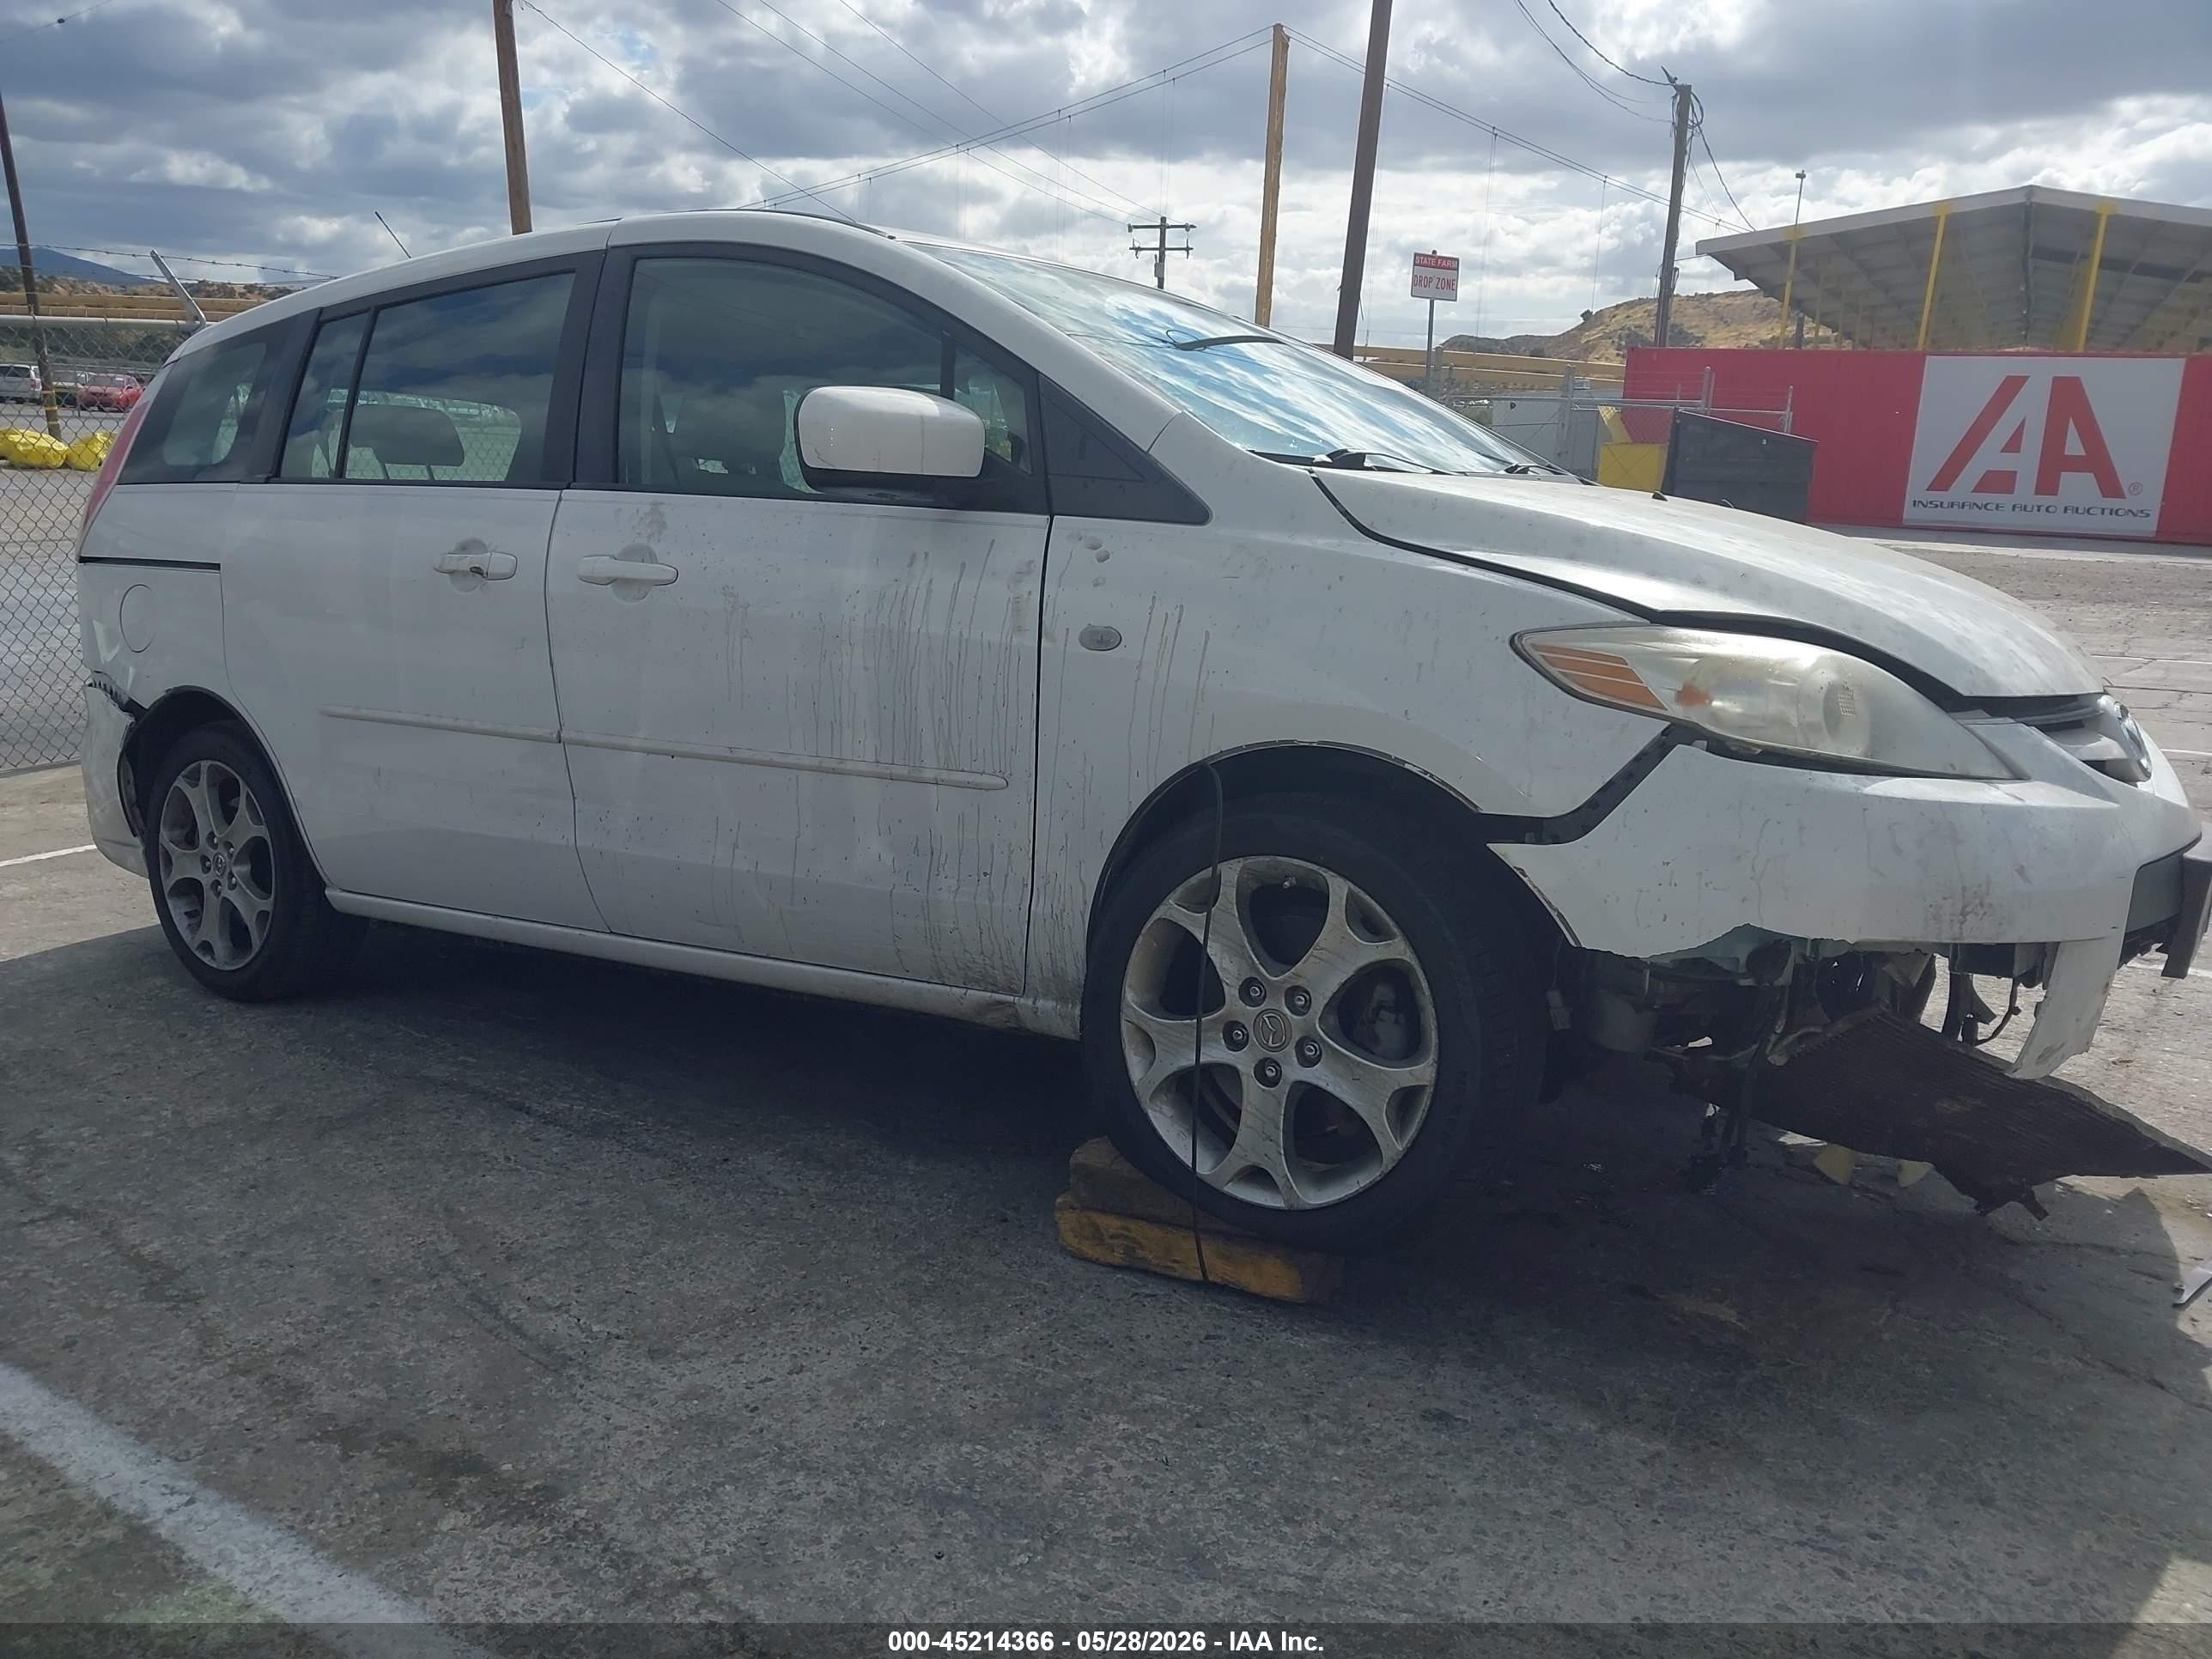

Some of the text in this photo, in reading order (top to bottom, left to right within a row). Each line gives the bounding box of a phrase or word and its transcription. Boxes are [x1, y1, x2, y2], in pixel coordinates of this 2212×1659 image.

[1415, 256, 1457, 268] STATE FARM
[1413, 275, 1456, 291] DROP ZONE
[1912, 499, 2151, 519] INSURANCE AUTO AUCTIONS
